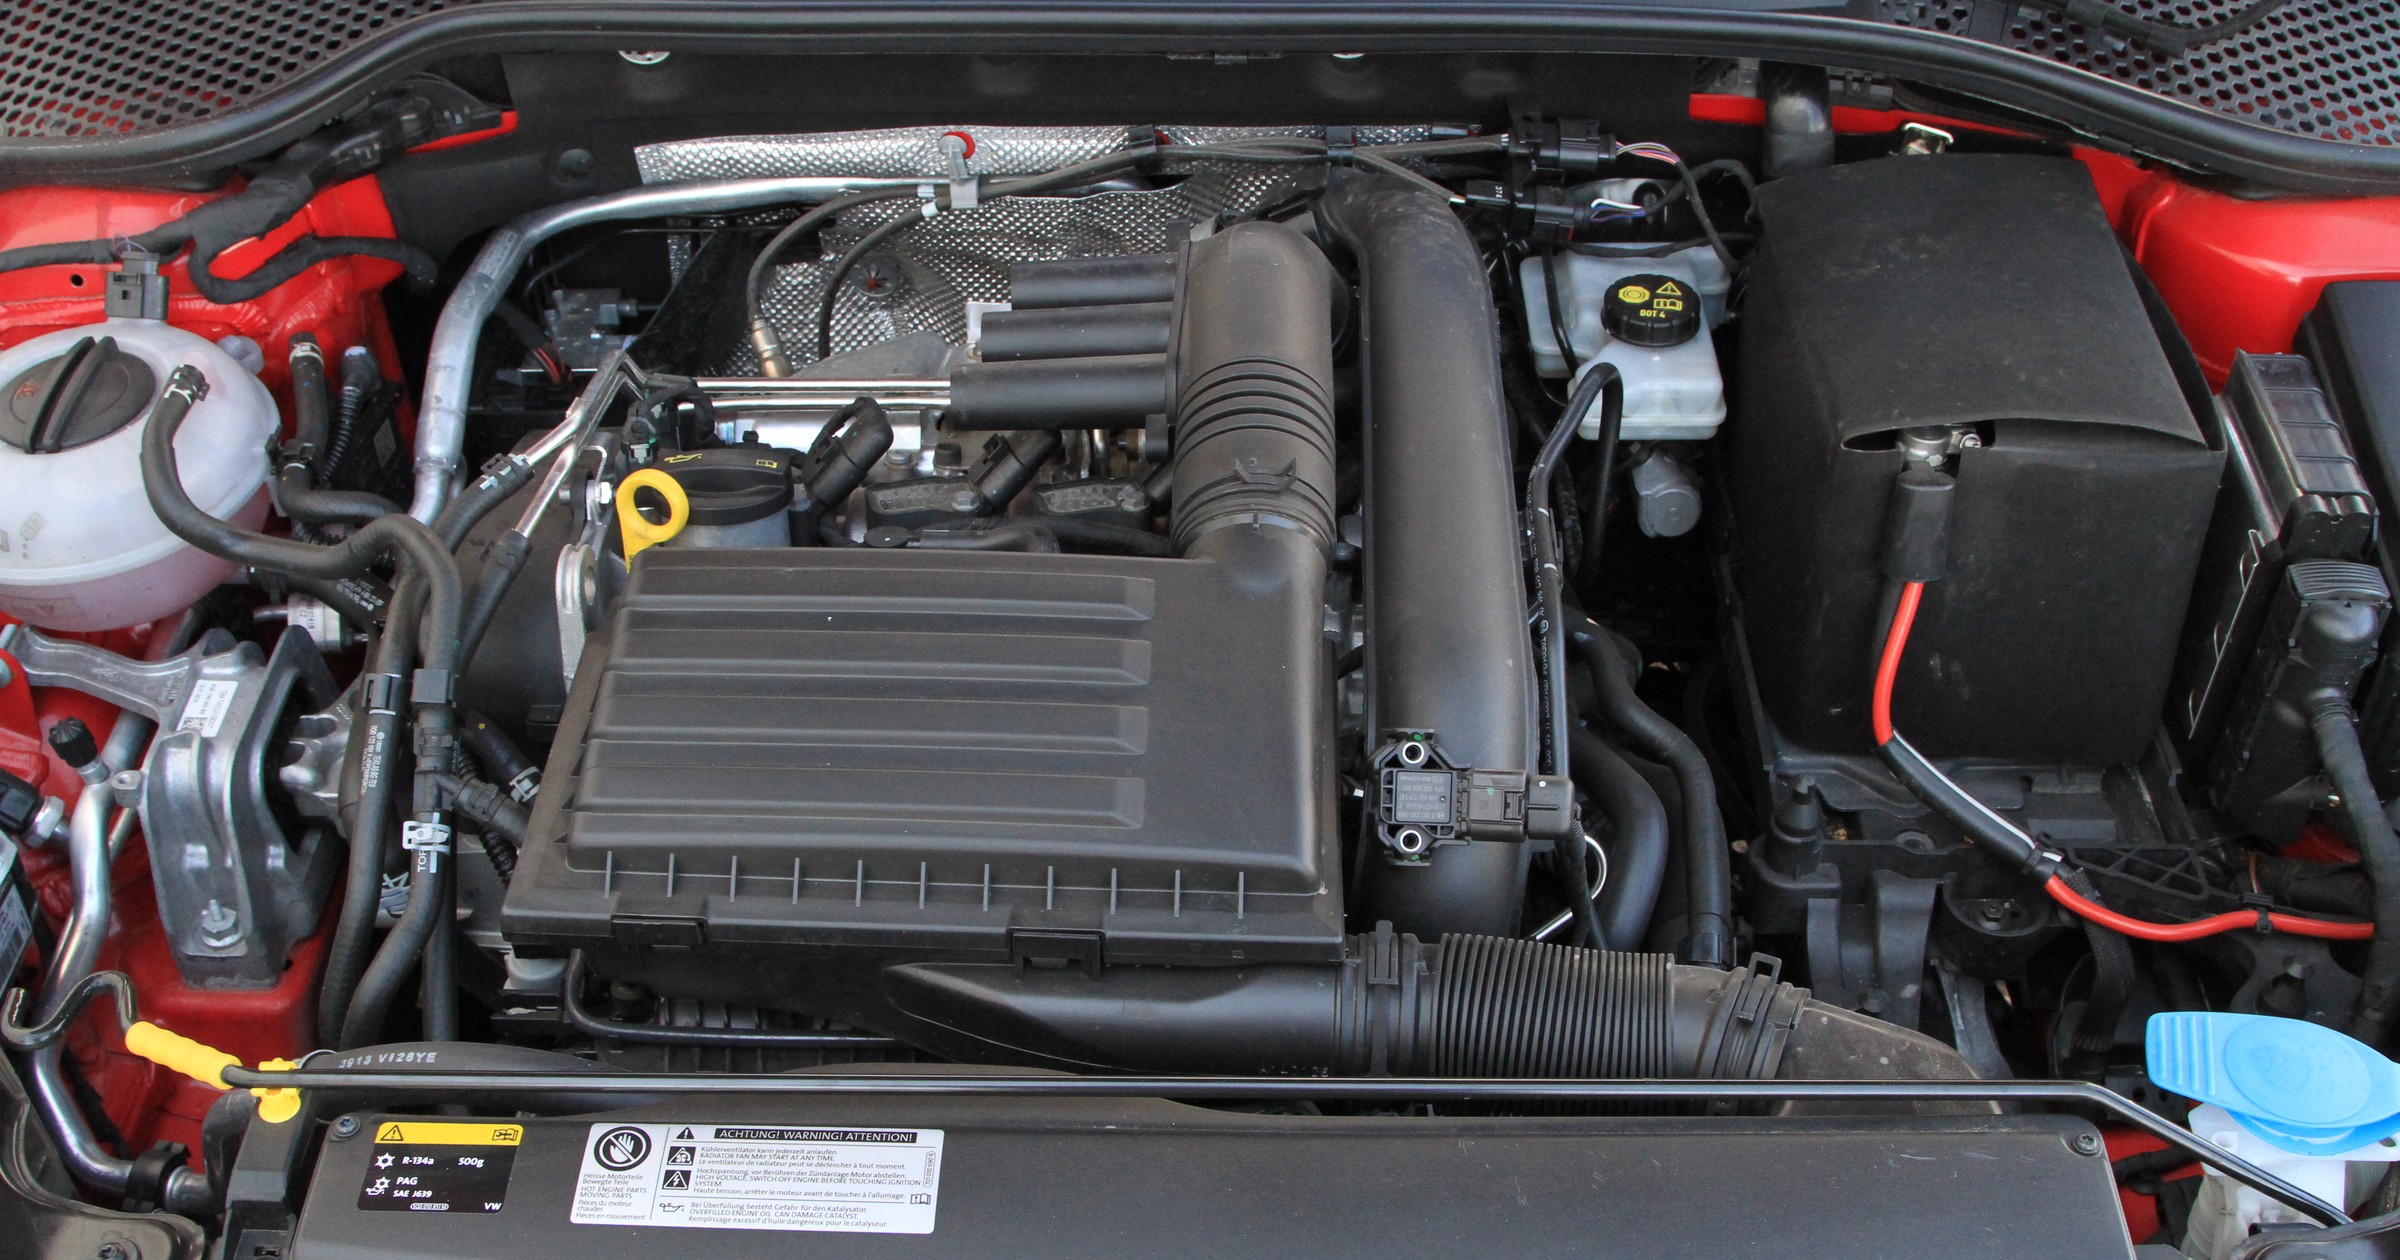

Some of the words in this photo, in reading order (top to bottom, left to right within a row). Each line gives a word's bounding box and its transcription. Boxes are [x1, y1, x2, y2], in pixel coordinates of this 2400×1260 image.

[1640, 309, 1657, 317] DOT
[720, 1130, 780, 1139] ACHTUNG!
[784, 1131, 843, 1140] WARNING!
[846, 1132, 912, 1142] ATTENTION!
[402, 1156, 435, 1165] R-134a
[458, 1157, 485, 1168] 500g
[809, 1170, 850, 1178] Zündanlage
[396, 1176, 419, 1185] PAG
[393, 1190, 409, 1198] SAE
[412, 1190, 433, 1198] J639
[484, 1202, 502, 1210] VW
[689, 1216, 732, 1224] Remplissage
[786, 1218, 824, 1226] dangereux
